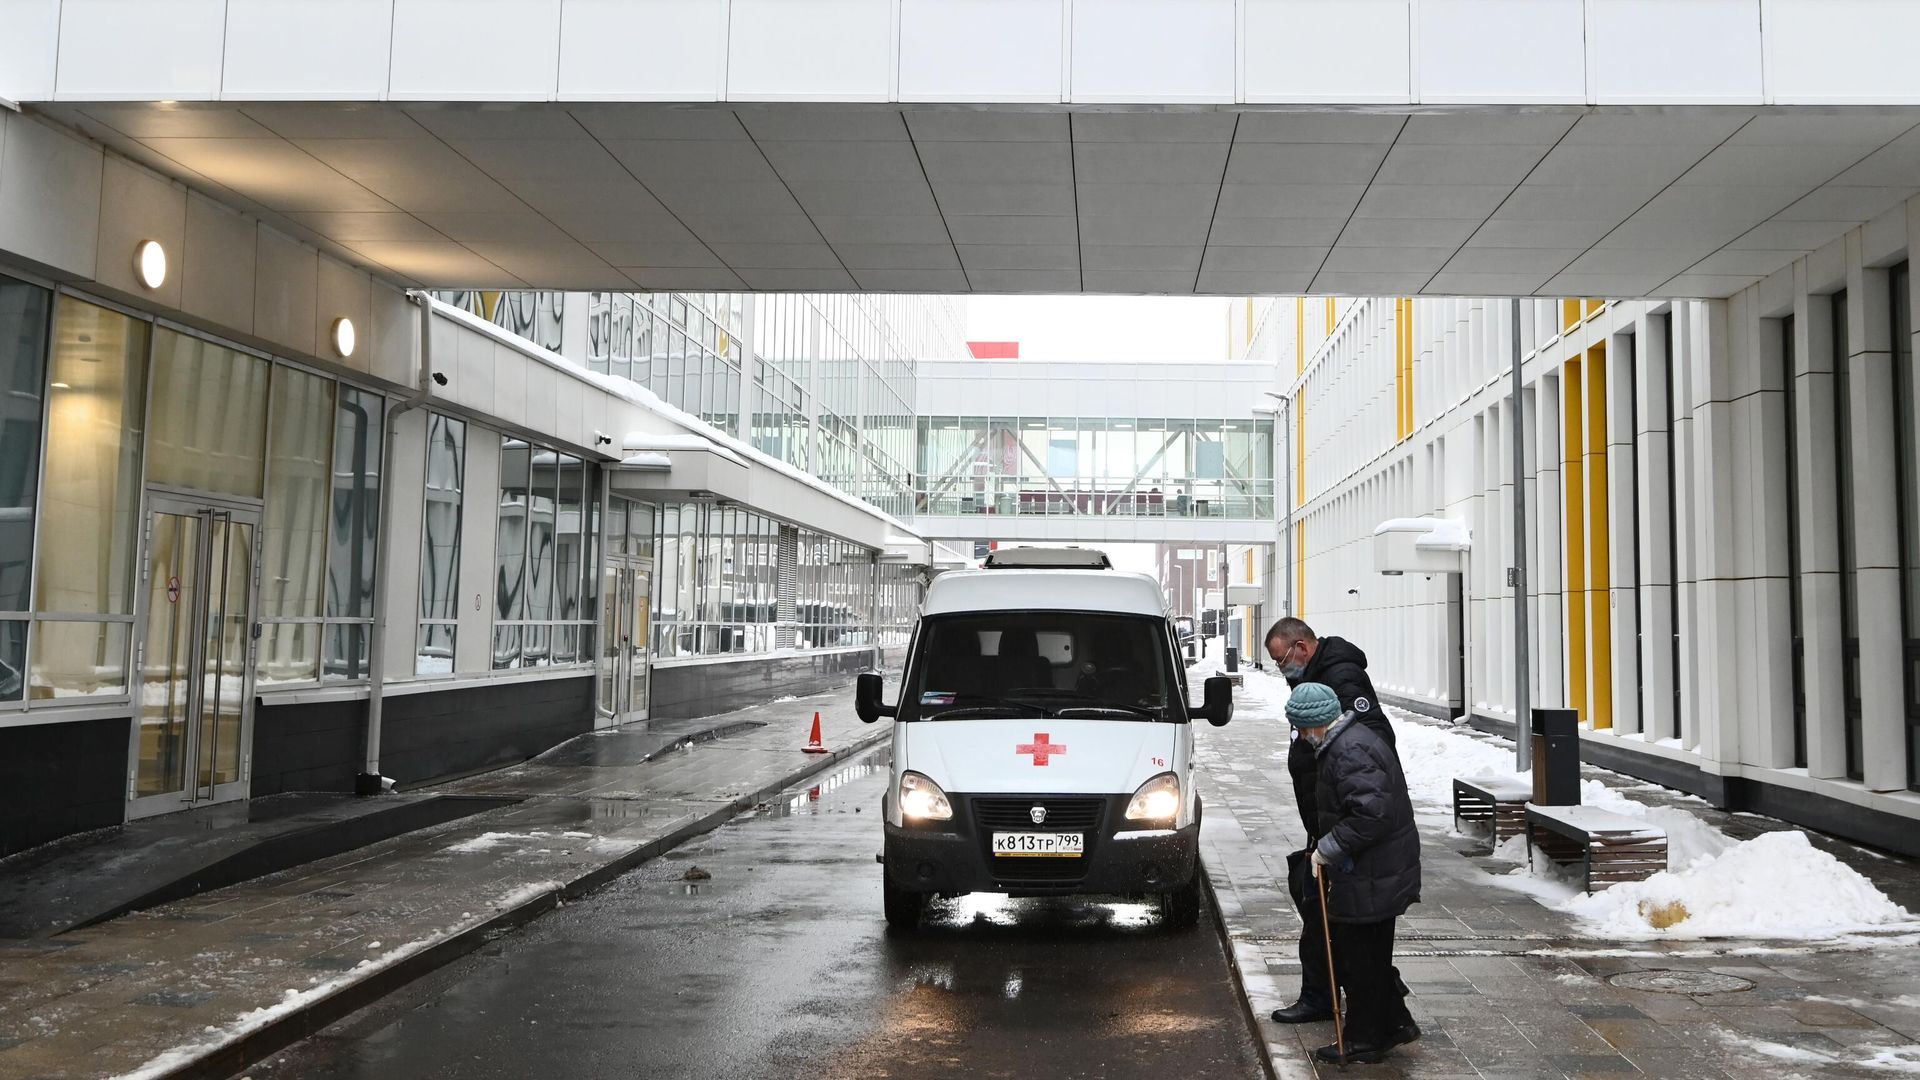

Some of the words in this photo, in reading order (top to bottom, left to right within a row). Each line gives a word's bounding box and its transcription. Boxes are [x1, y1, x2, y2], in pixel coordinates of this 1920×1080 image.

[1151, 757, 1164, 767] 16
[997, 836, 1054, 850] К813ТР
[1057, 835, 1079, 846] 799
